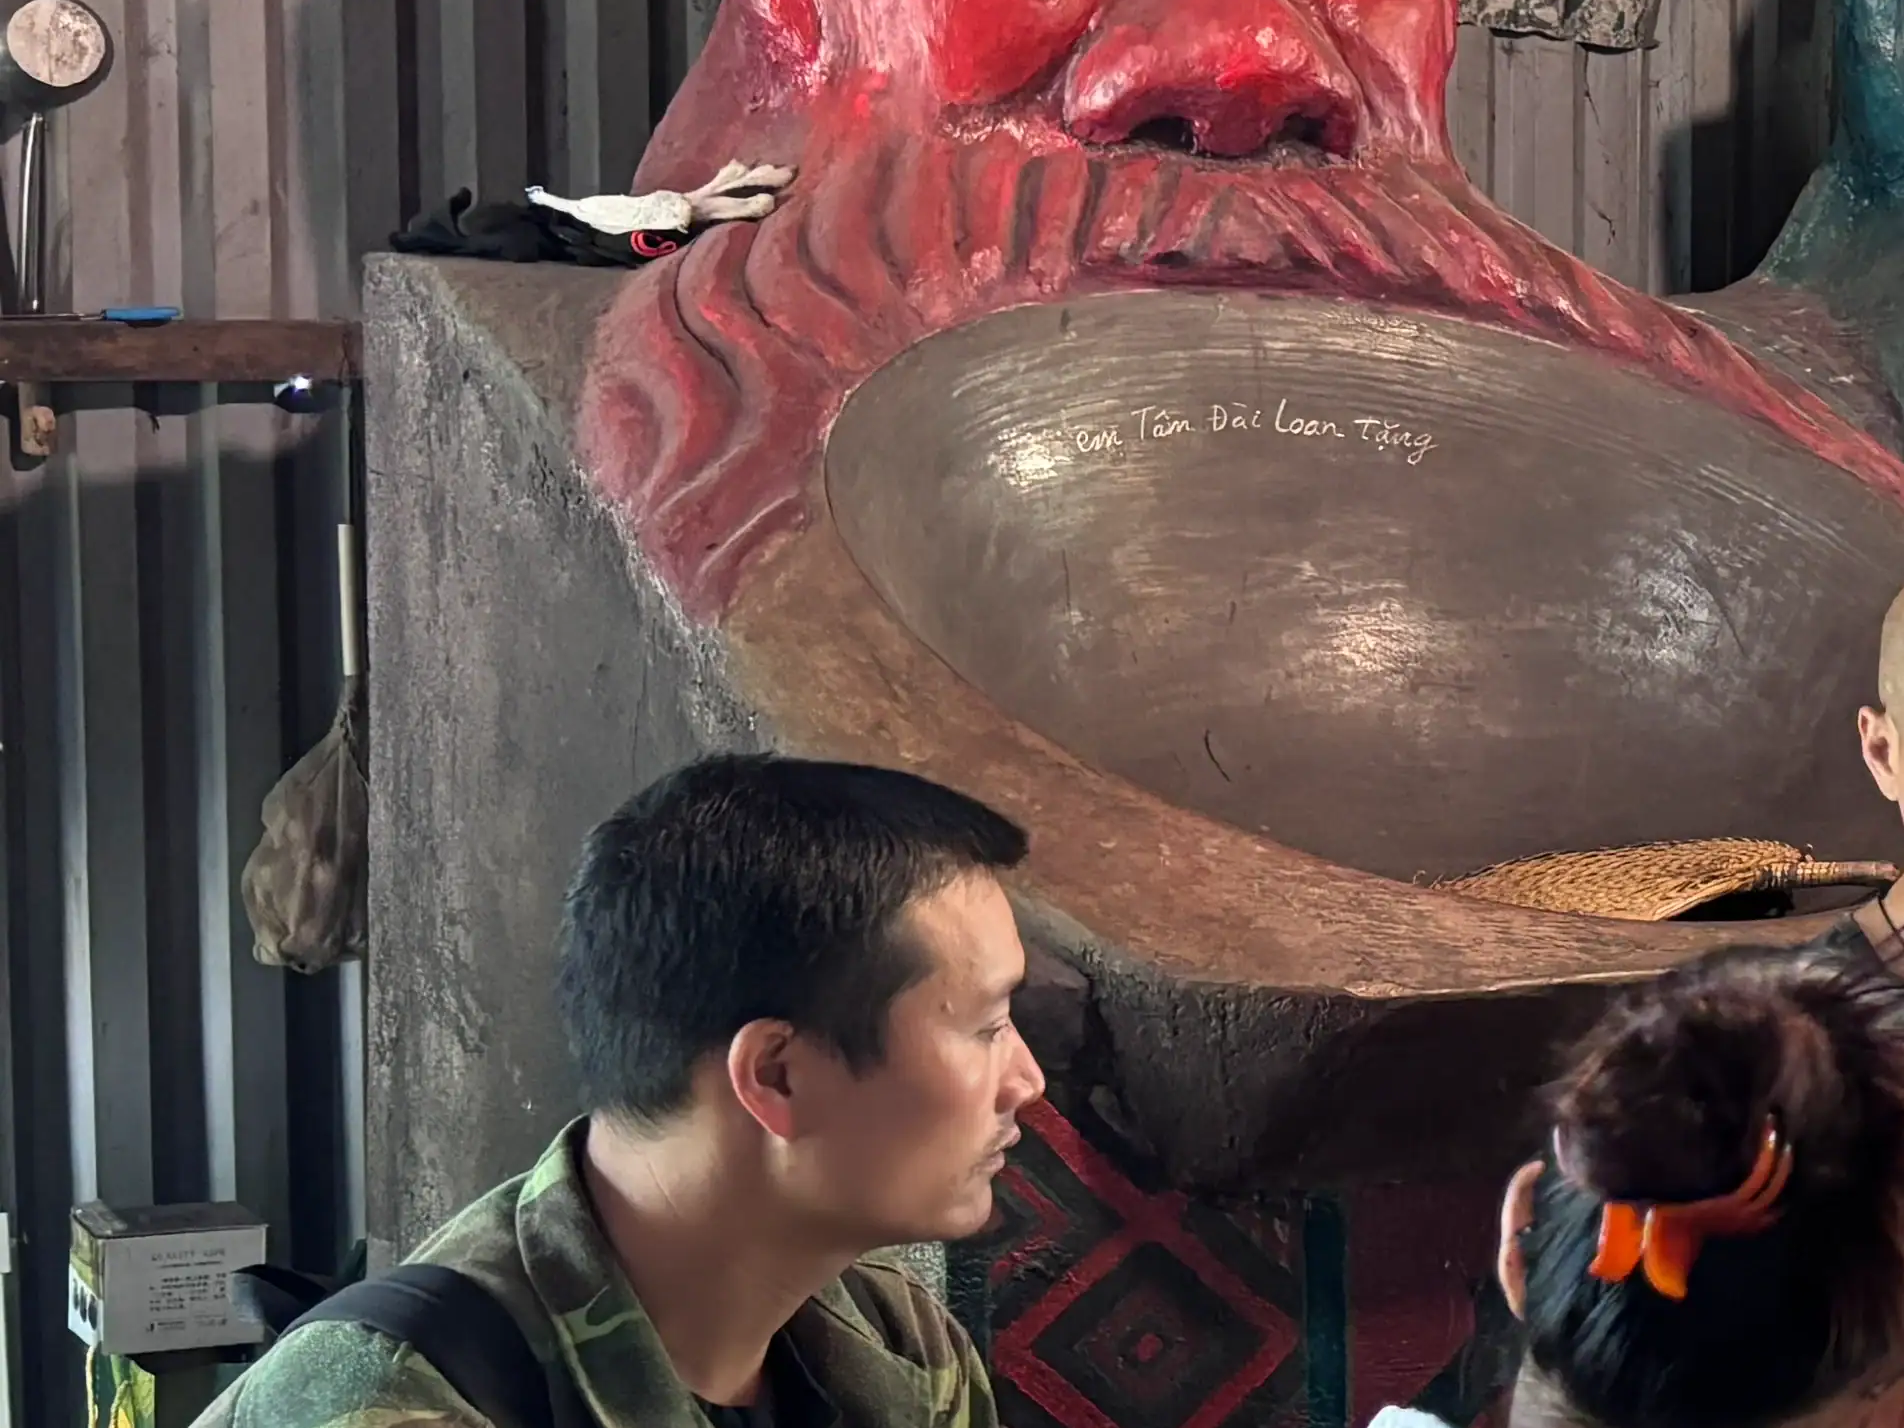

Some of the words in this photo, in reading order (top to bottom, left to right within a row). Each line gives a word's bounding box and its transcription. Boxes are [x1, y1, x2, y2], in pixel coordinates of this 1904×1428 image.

[1131, 406, 1195, 440] Tâm
[1206, 402, 1261, 432] Đài
[1275, 398, 1345, 437] Loan
